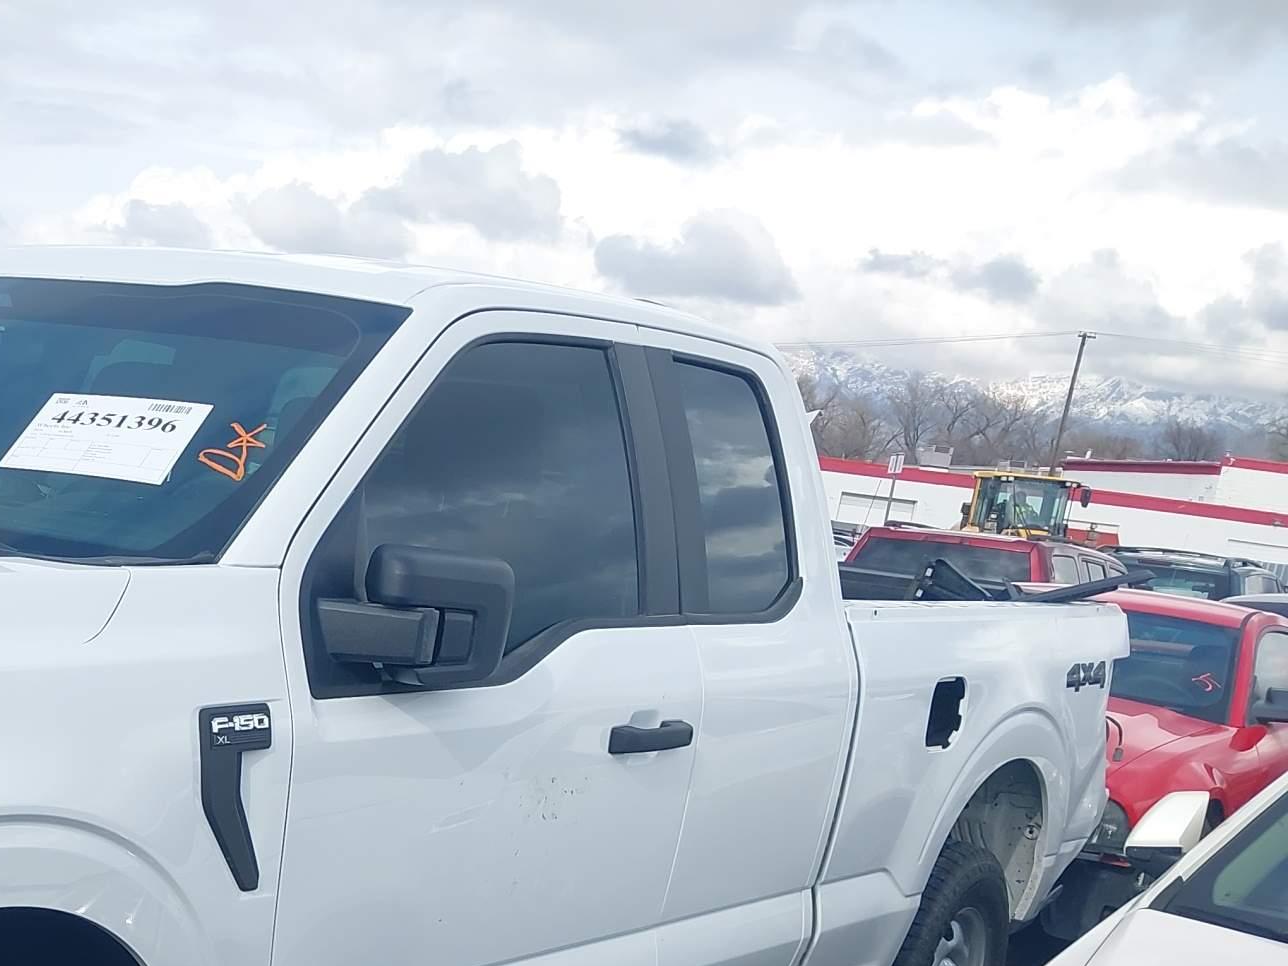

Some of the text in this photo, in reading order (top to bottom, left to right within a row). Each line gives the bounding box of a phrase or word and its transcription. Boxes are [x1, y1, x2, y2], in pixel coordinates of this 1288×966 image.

[51, 410, 183, 433] 44351396
[211, 714, 269, 733] F-150
[216, 735, 231, 745] XL
